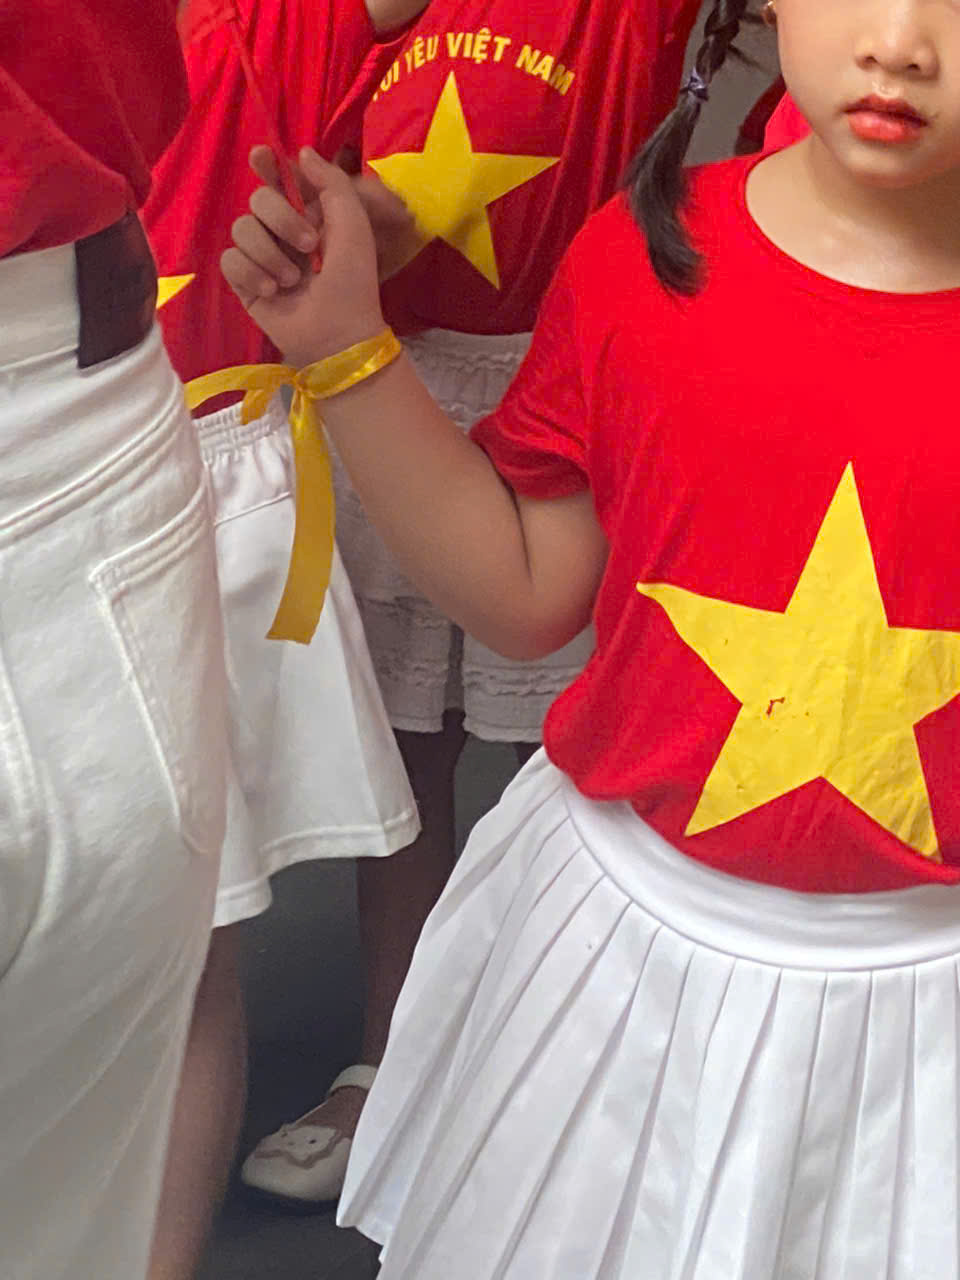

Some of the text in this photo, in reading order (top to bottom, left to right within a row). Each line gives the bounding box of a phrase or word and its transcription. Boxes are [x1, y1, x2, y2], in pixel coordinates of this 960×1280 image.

[404, 35, 440, 74] YÊU
[446, 27, 512, 64] VIỆT
[515, 44, 576, 97] NAM
